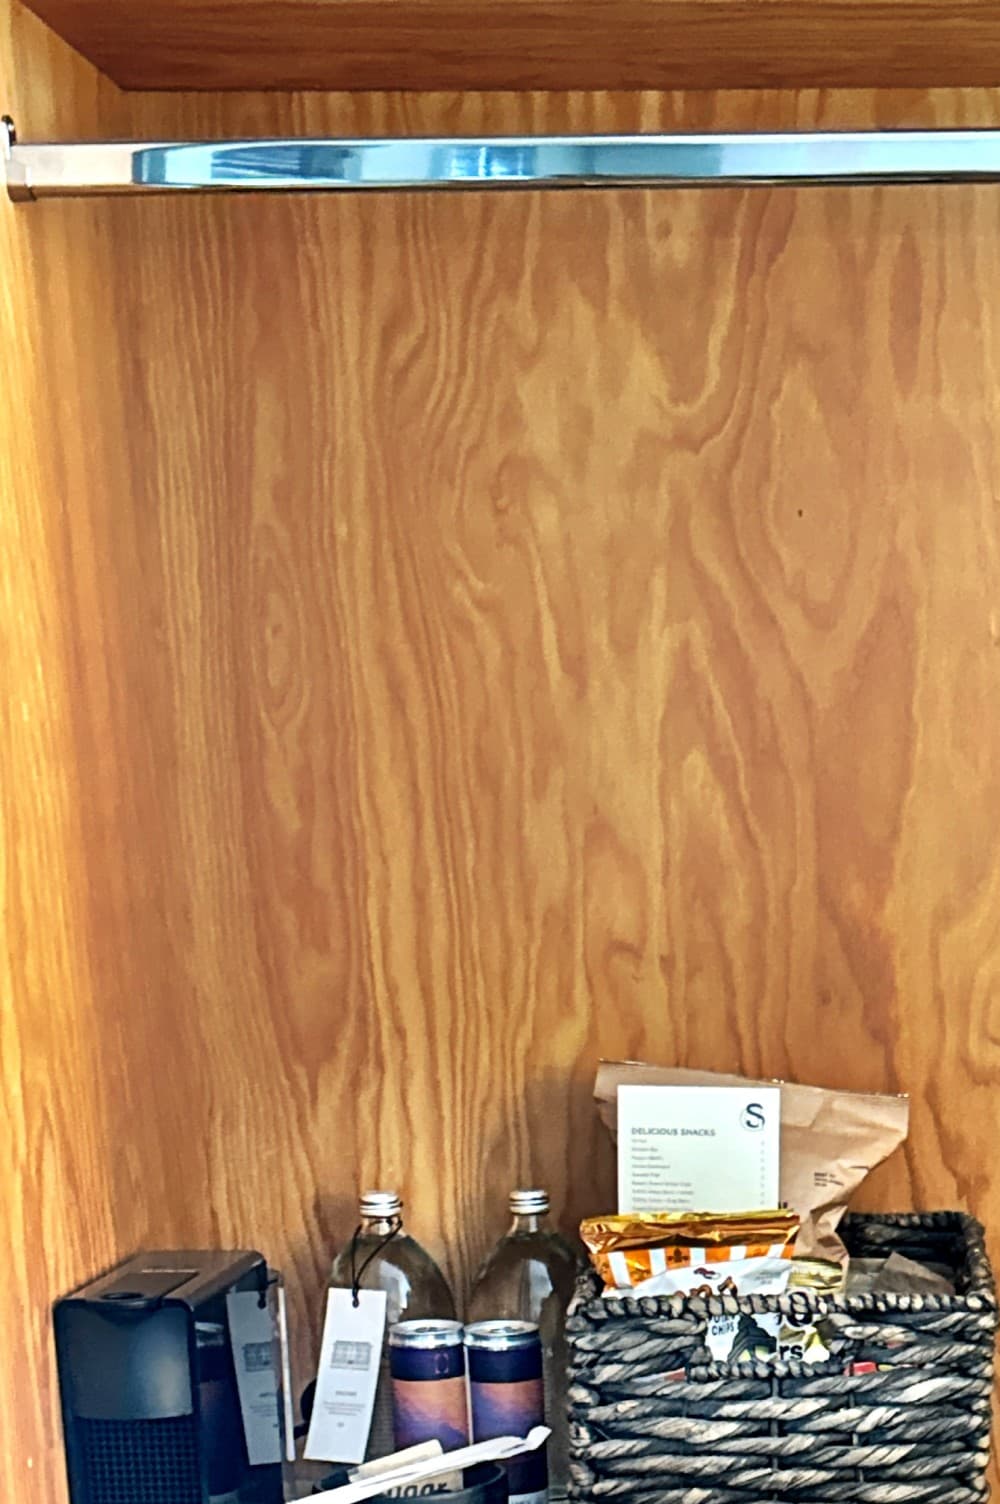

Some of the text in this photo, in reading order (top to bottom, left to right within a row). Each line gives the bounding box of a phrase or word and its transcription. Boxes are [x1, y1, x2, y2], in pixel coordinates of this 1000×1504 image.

[746, 1103, 766, 1129] S
[631, 1127, 716, 1137] DELICIOUS SNACKS
[711, 1321, 735, 1336] CHIPS
